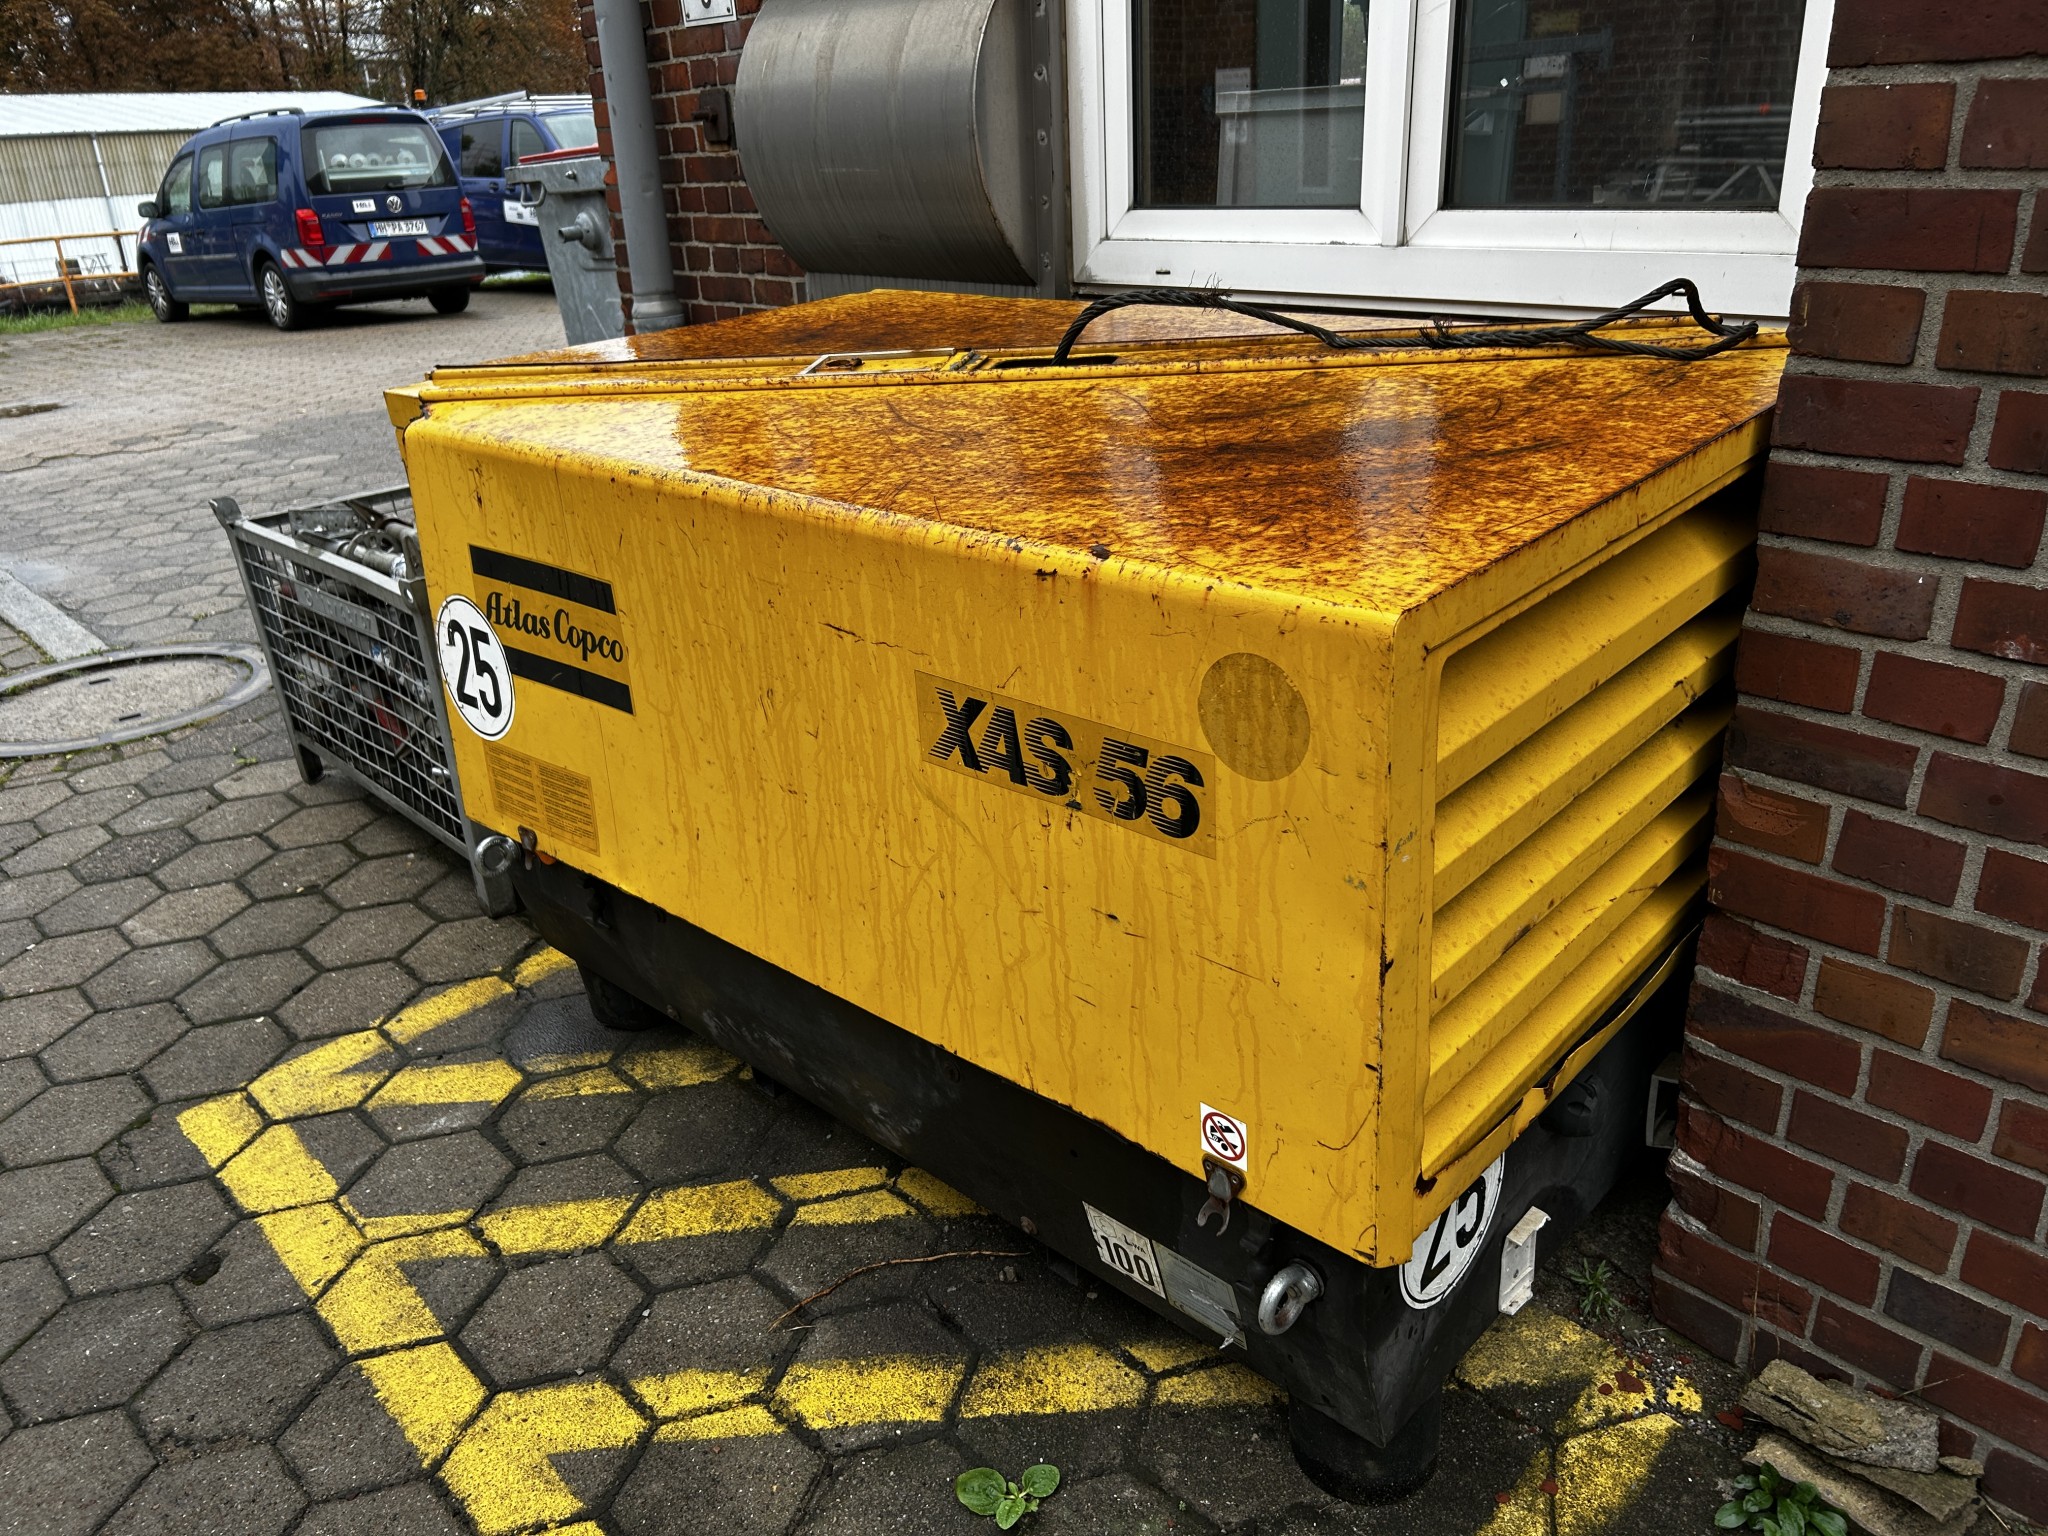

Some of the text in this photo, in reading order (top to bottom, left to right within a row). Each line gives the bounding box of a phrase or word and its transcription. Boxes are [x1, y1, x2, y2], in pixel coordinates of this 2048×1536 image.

[448, 619, 503, 719] 25
[486, 591, 624, 663] Atlas Copco
[928, 686, 1206, 839] XAS 56
[1100, 1235, 1156, 1287] 100
